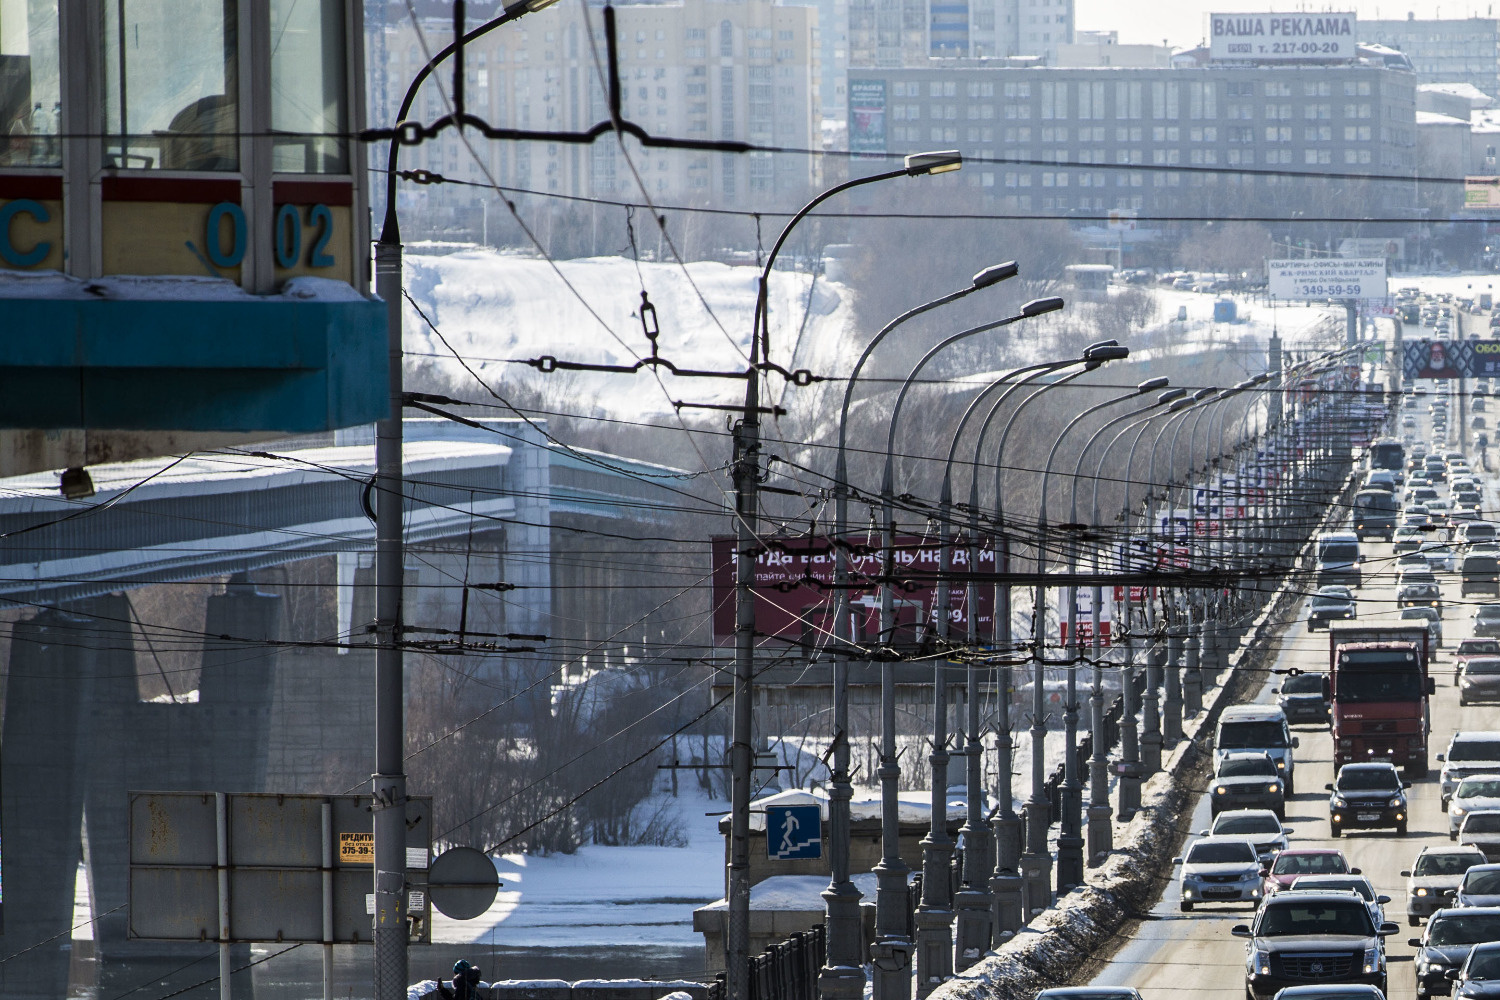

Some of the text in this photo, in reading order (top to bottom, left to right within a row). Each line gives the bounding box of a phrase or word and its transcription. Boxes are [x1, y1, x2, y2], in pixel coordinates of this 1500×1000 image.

[1214, 18, 1352, 36] ВАША РЕКЛАМА
[1273, 43, 1339, 53] 217-00-20
[1302, 285, 1361, 295] 349-59-59
[341, 834, 374, 842] КРЕДИТУ
